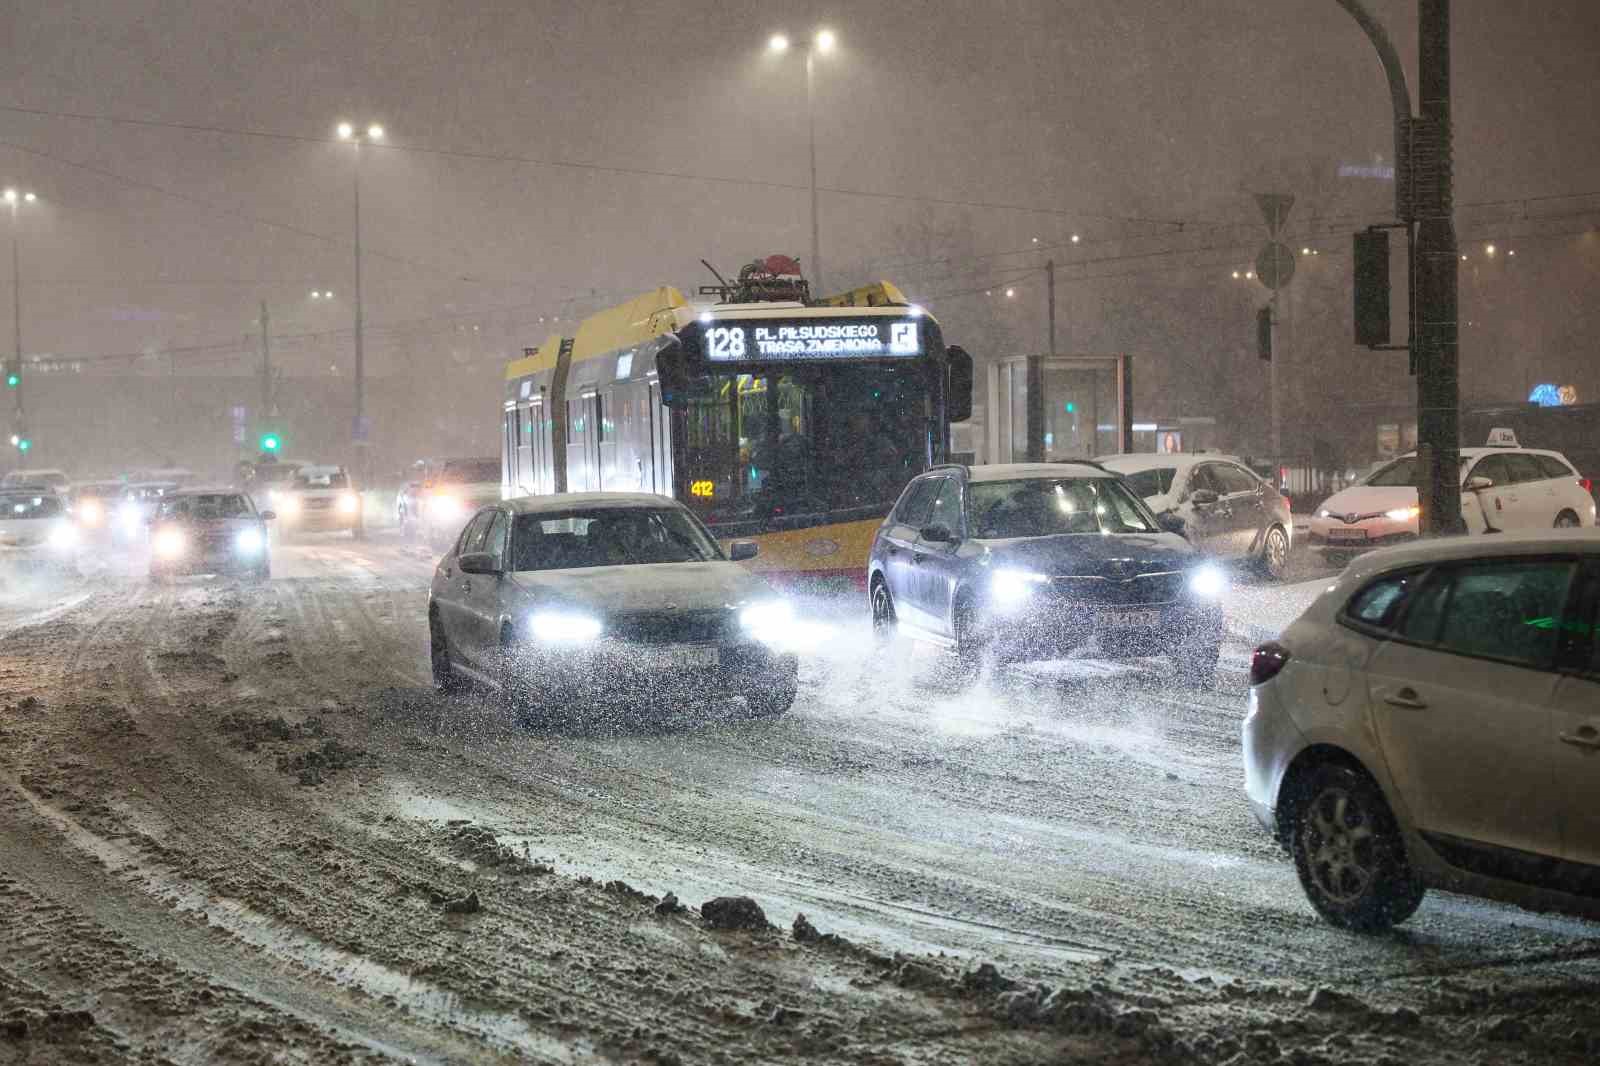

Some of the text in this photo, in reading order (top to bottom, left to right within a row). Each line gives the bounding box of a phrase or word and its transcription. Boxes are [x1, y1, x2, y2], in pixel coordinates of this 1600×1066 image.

[755, 326, 878, 340] PL. PIŁSUDSKIEGO
[705, 327, 745, 356] 128
[757, 339, 882, 353] TRASA ZMIENIONA
[691, 481, 713, 496] 412
